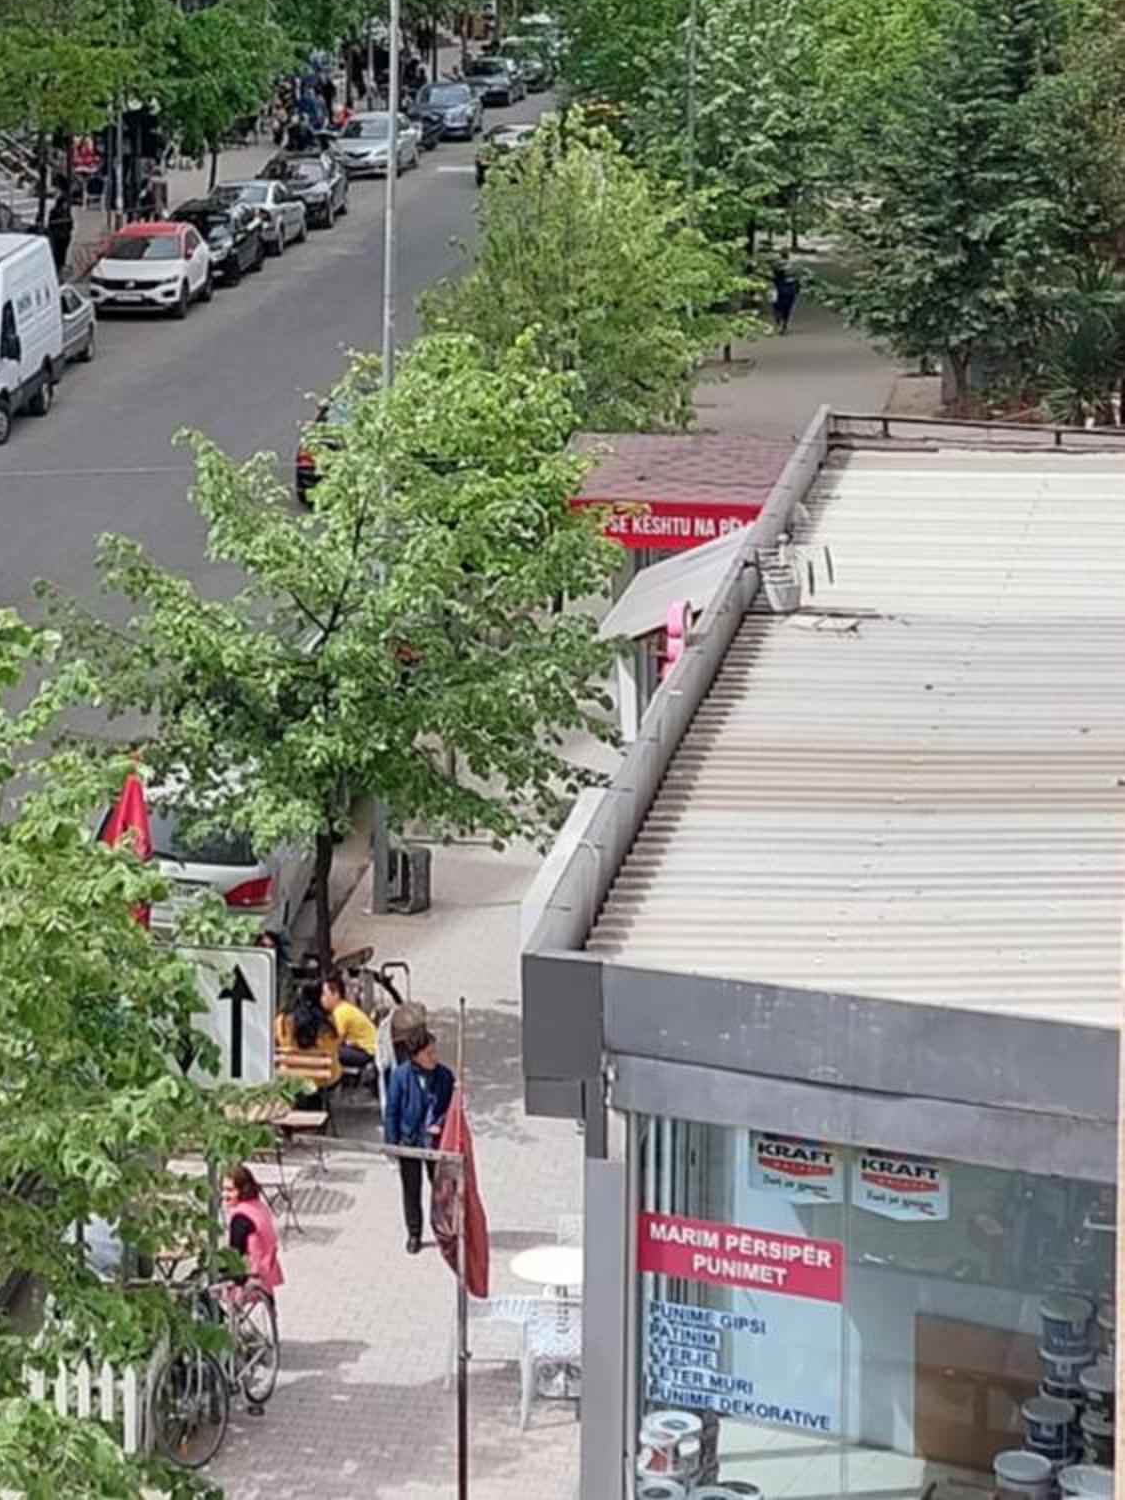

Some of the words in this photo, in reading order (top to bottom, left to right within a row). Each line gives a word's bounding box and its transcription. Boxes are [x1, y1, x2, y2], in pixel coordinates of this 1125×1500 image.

[694, 517, 716, 536] NA
[758, 1141, 834, 1164] KRAFT
[861, 1156, 940, 1180] KRAFT
[649, 1222, 720, 1250] MARIM
[725, 1233, 832, 1268] PËRSIPËR
[692, 1253, 788, 1285] PUNIMET
[649, 1301, 715, 1325] PUNIME
[720, 1313, 767, 1335] GIPSI
[649, 1321, 717, 1347] PATINIM
[649, 1343, 714, 1366] LYERJE
[709, 1374, 754, 1395] MURI
[649, 1384, 715, 1408] PUNIME
[719, 1398, 832, 1431] DEKORATIVE
